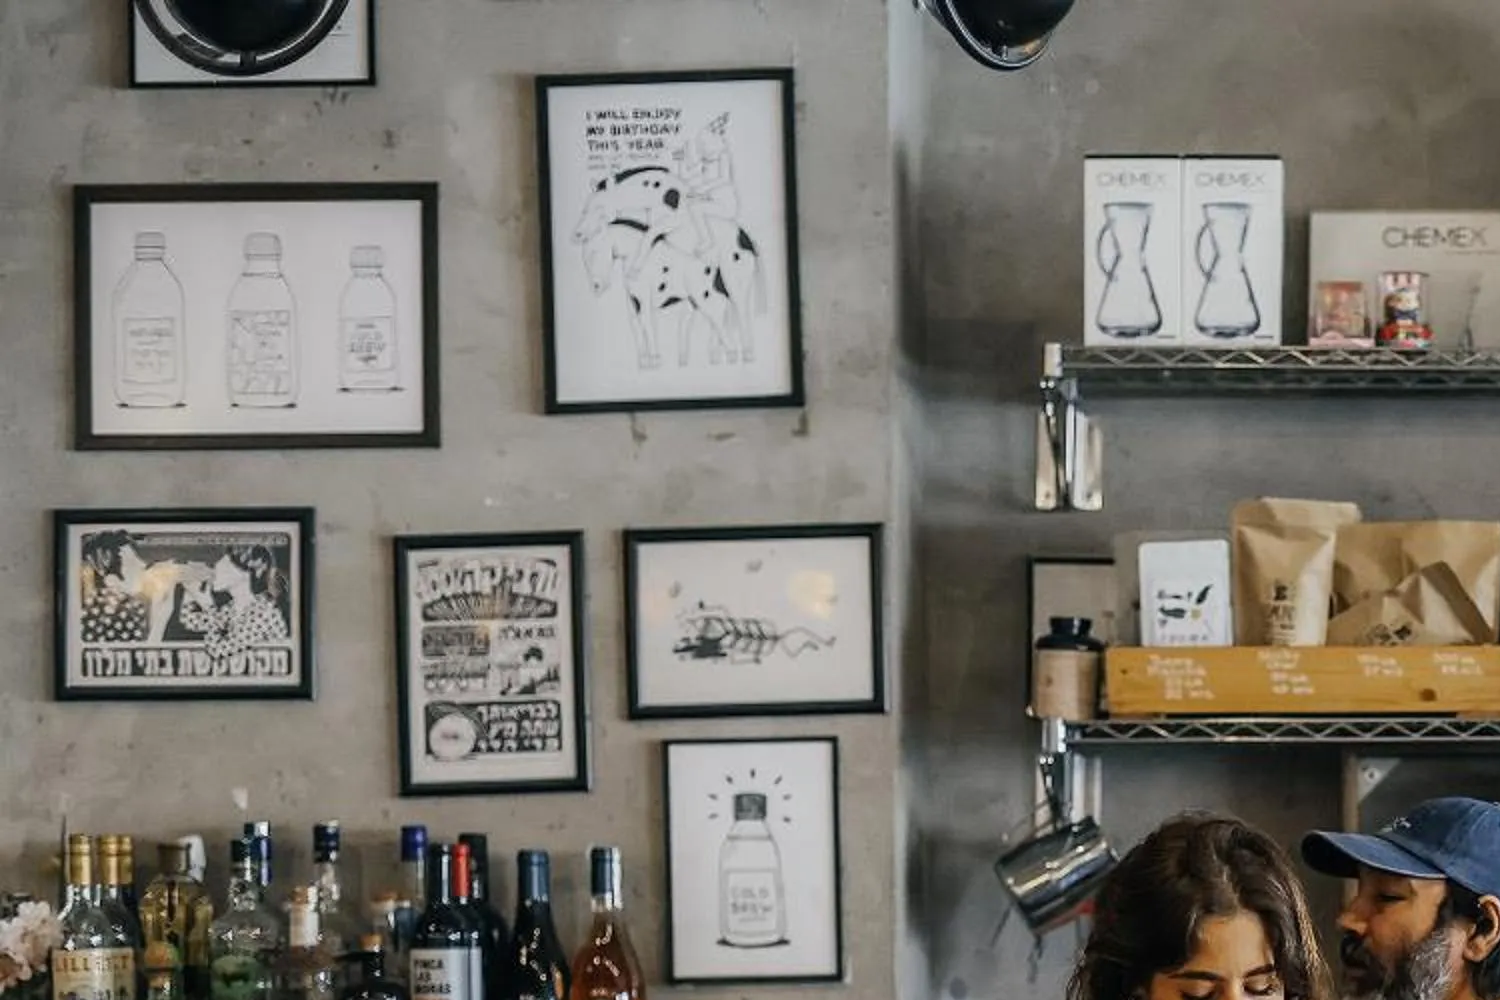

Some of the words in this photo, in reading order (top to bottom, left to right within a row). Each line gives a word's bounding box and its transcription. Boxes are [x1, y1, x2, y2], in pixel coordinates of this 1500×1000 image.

[1096, 171, 1167, 188] CHEMEX
[1195, 171, 1267, 188] CHEMEX
[1381, 225, 1489, 249] CHEMEX
